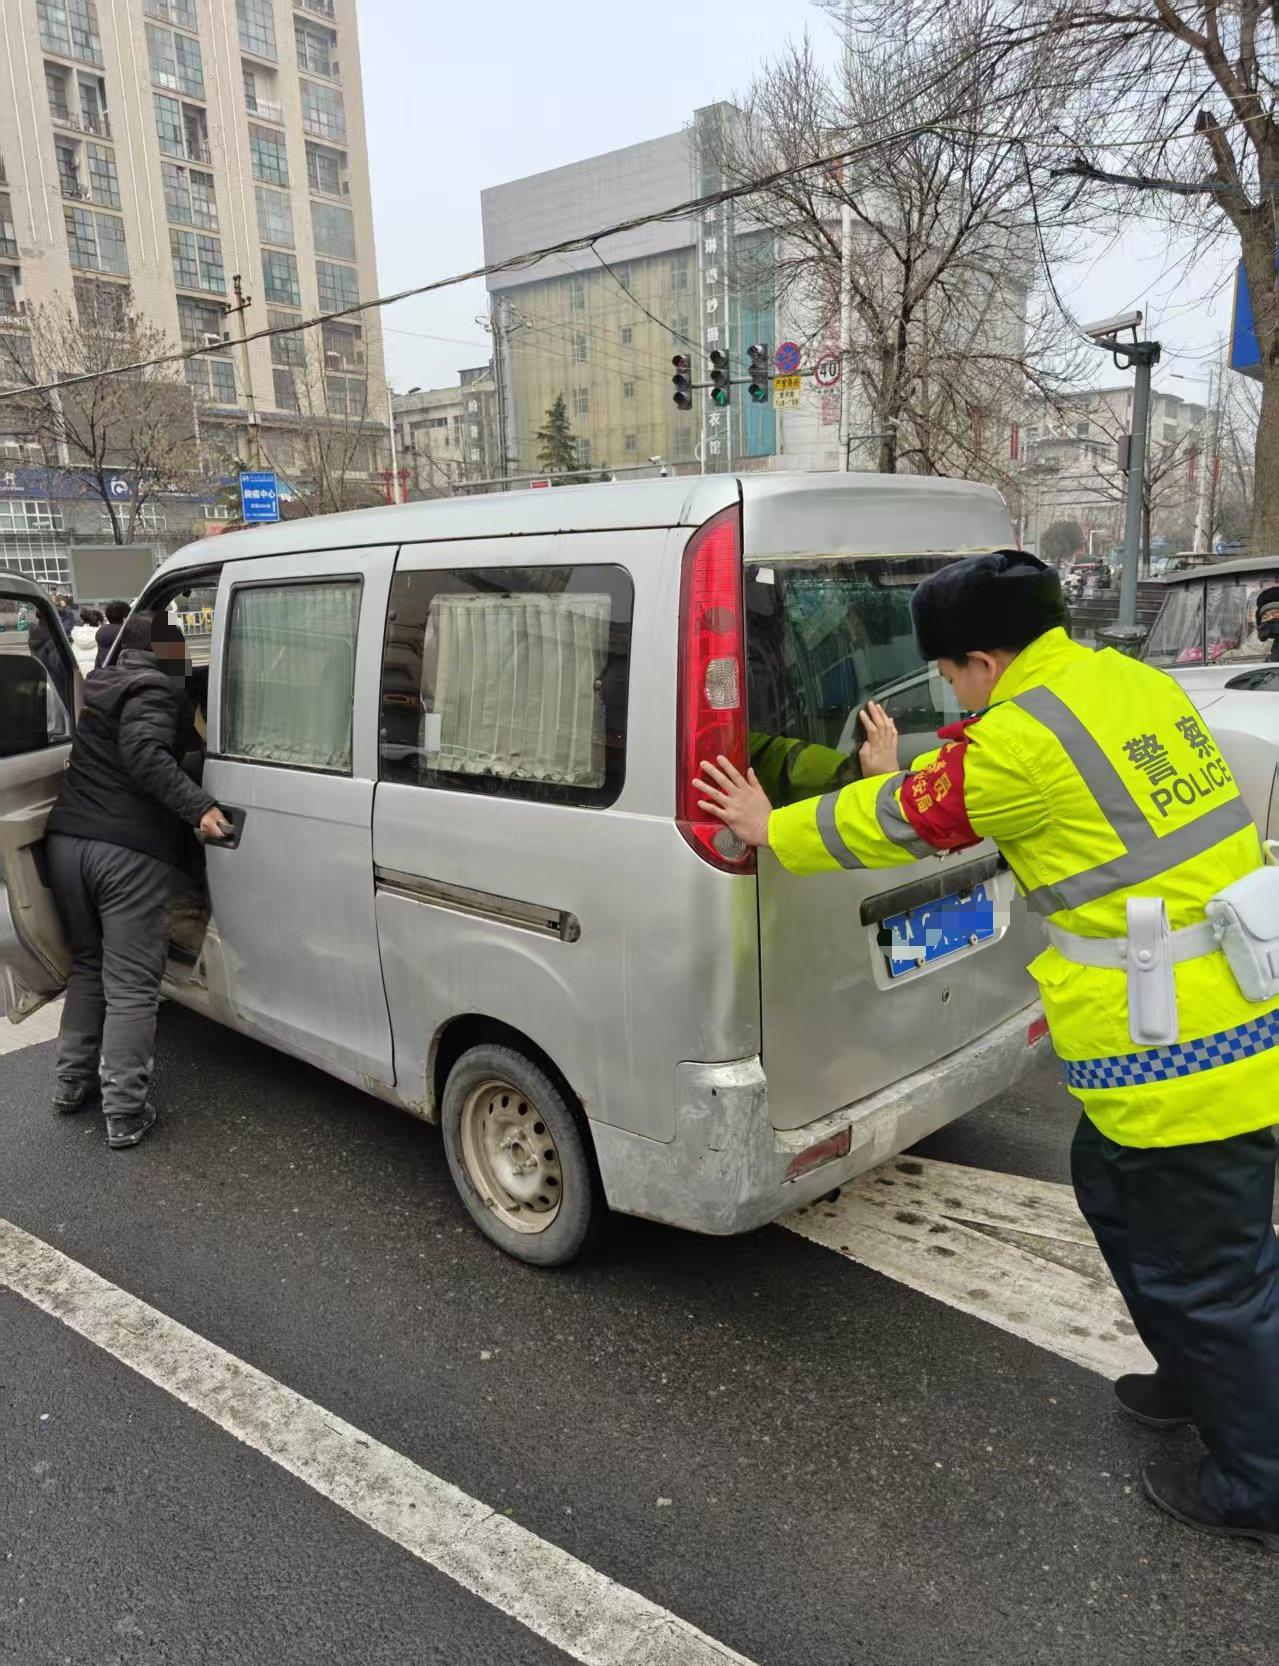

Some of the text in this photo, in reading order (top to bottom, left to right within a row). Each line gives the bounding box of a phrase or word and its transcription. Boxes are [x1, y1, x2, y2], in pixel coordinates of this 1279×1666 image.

[820, 362, 836, 377] 40
[1122, 715, 1216, 787] 警察
[1150, 757, 1232, 818] POLICE
